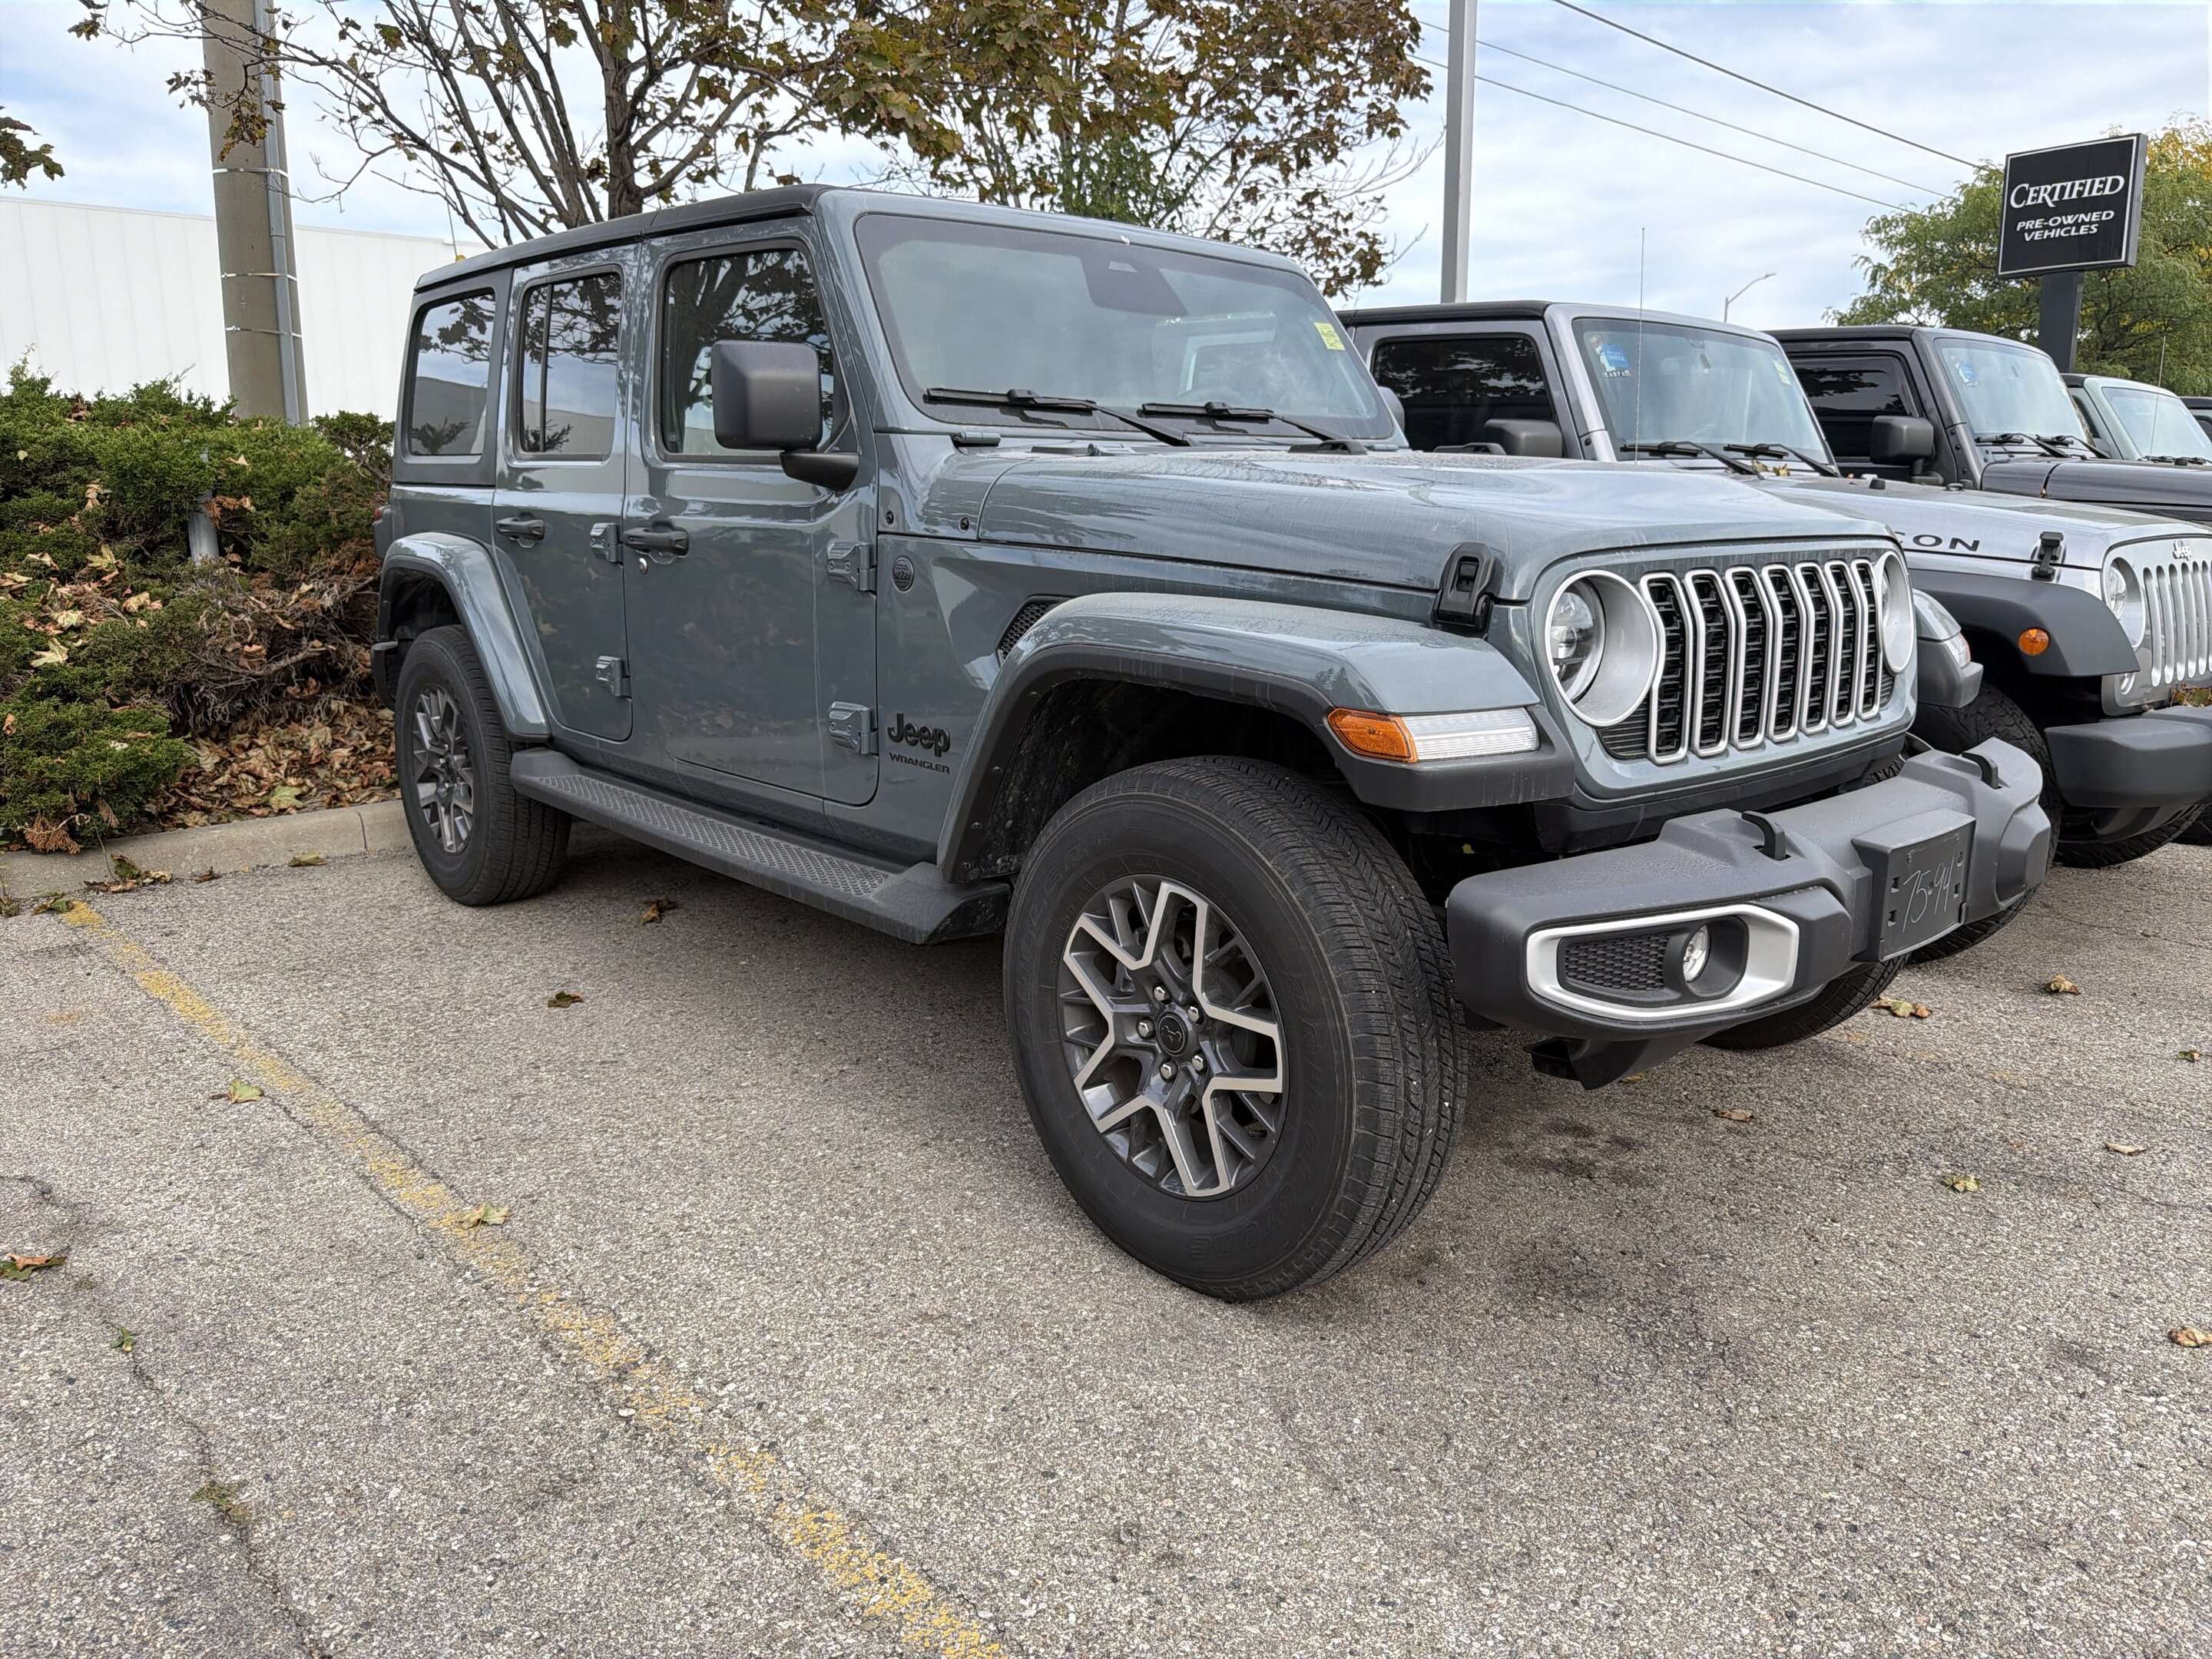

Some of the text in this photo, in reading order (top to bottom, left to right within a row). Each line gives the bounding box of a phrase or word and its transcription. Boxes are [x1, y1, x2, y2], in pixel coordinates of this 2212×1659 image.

[2016, 210, 2114, 231] PRE-OWNED
[2024, 224, 2098, 242] VEHICLES
[887, 713, 950, 757] Jeep
[889, 752, 950, 774] WRANGLER
